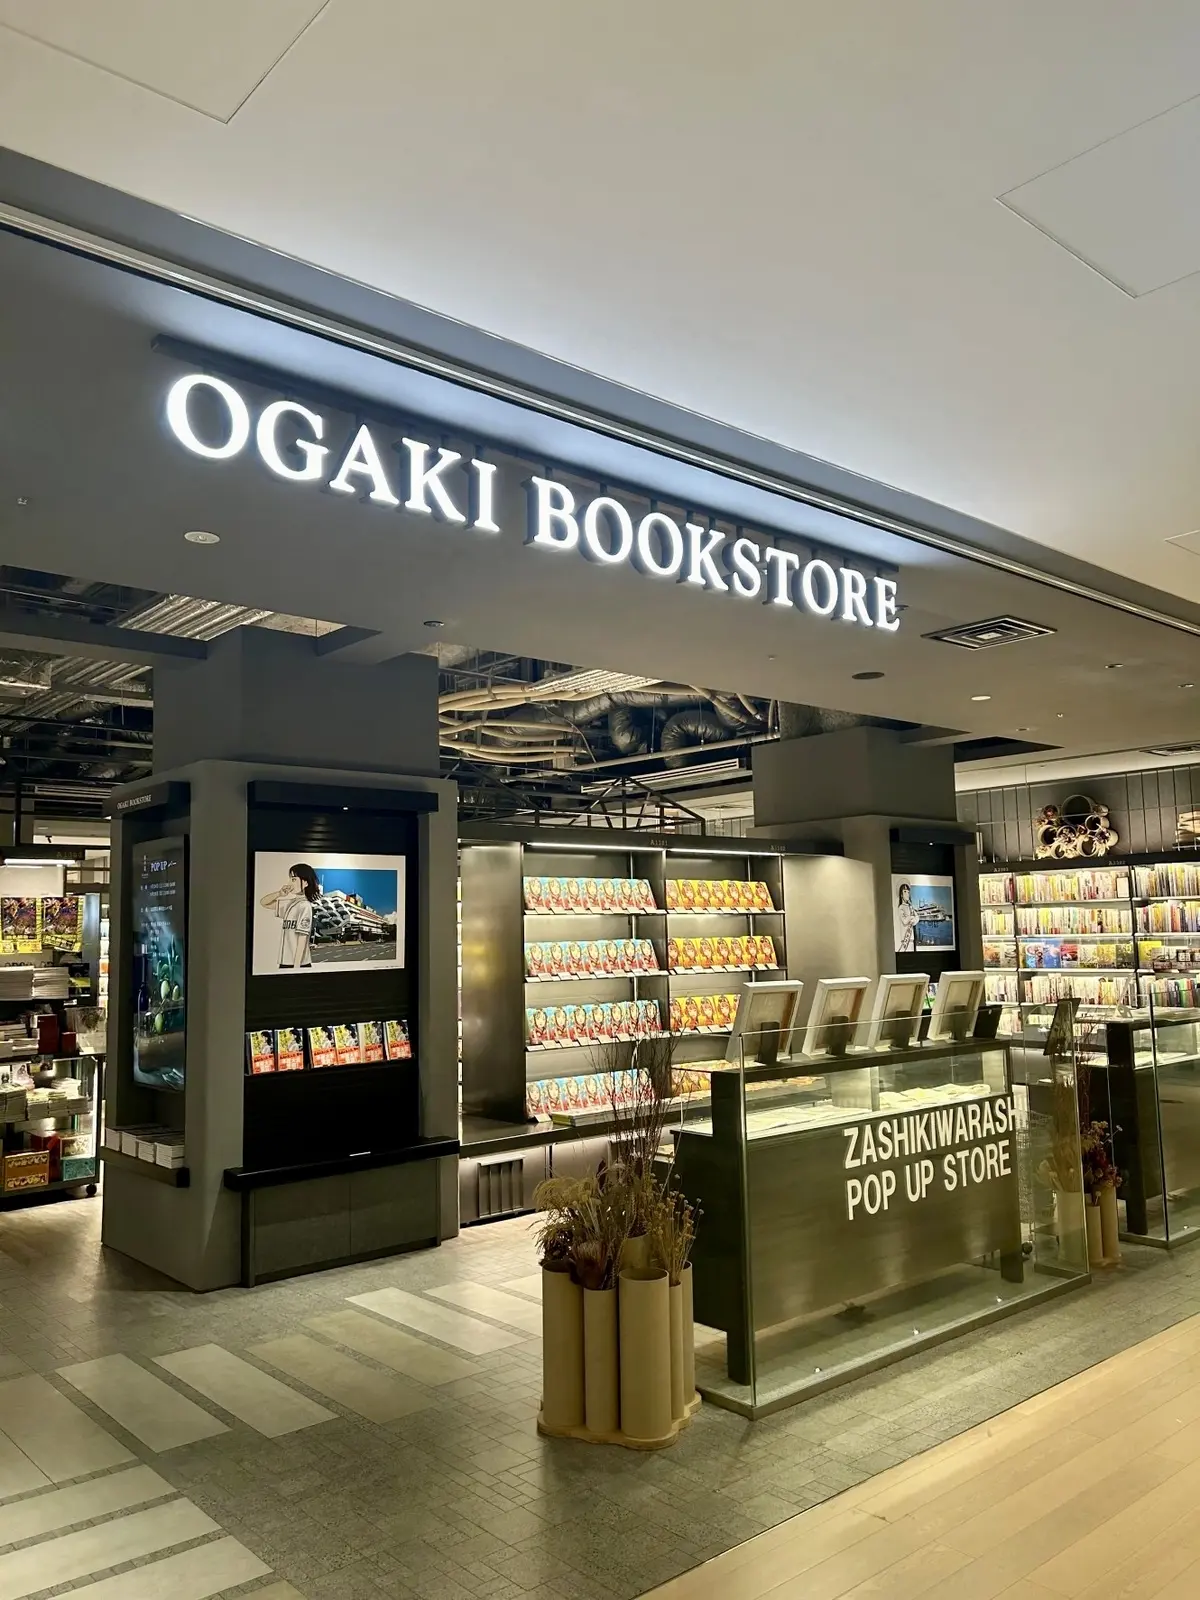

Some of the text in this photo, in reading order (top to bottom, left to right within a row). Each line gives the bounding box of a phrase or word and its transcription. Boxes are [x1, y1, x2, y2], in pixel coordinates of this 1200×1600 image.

[166, 373, 901, 632] OGAKI BOOKSTORE
[846, 1139, 1012, 1221] POP UP STORE
